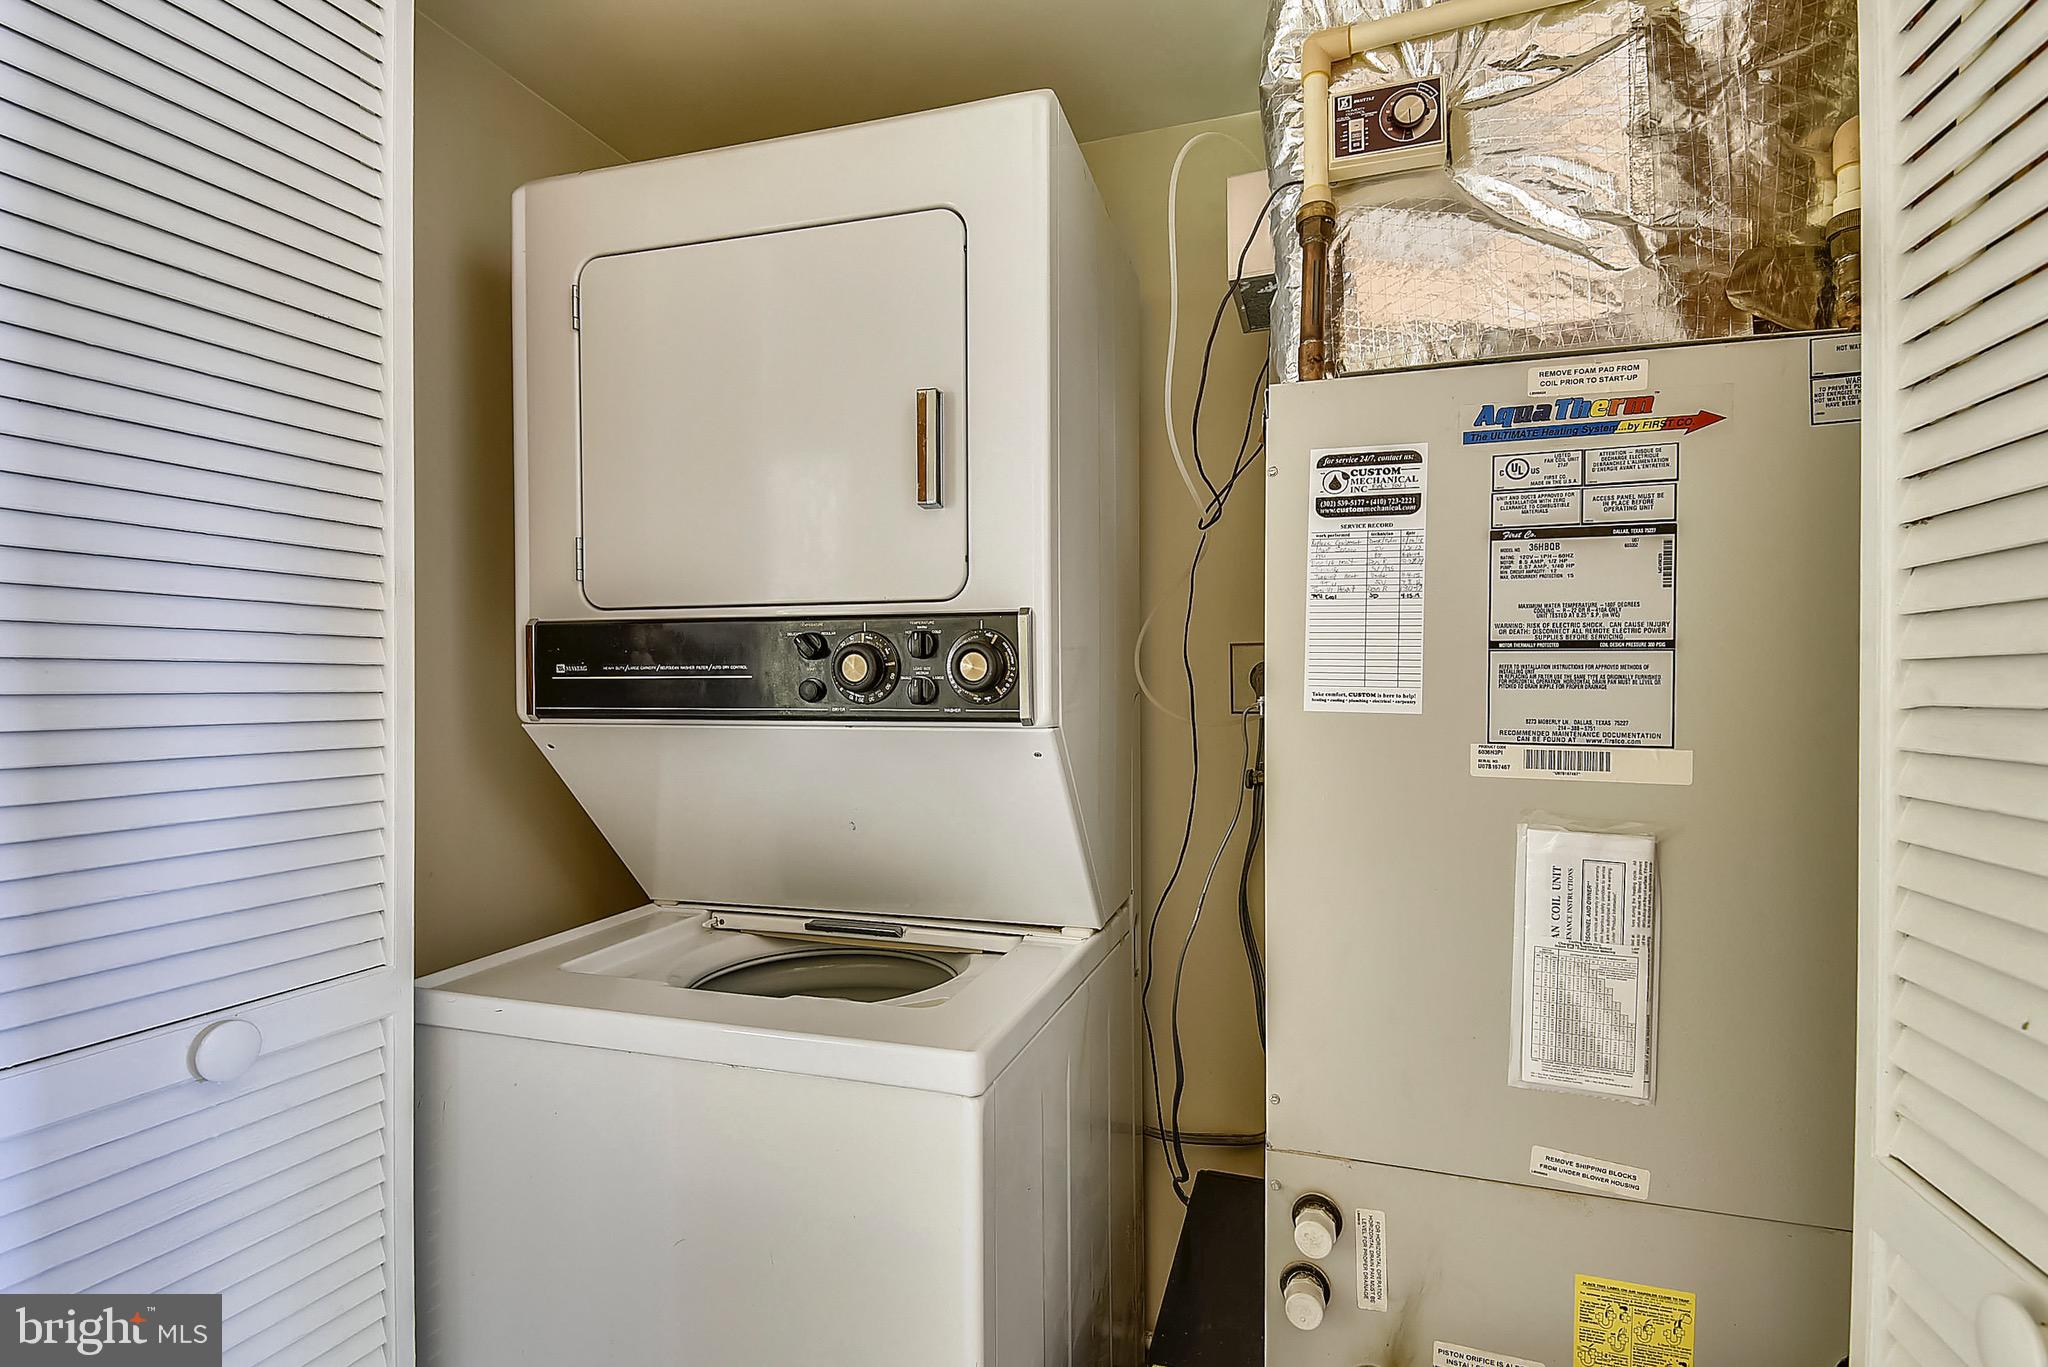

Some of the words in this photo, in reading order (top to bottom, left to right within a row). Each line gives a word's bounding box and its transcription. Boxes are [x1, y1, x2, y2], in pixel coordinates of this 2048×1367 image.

[1539, 368, 1572, 378] REMOVE
[1574, 366, 1596, 375] FOAM
[1599, 366, 1615, 374] PAD
[1617, 364, 1640, 372] FROM
[1540, 379, 1558, 387] COIL
[1599, 374, 1638, 383] START-UP
[1471, 433, 1488, 442] The
[1490, 430, 1538, 440] ULTIMATE
[1541, 427, 1578, 438] Heating
[1643, 418, 1672, 429] FIRST
[1676, 418, 1695, 427] CO.
[1322, 458, 1334, 466] for
[1350, 467, 1401, 477] CUSTOM
[1511, 463, 1524, 475] UL
[1530, 467, 1540, 475] US
[1350, 475, 1418, 485] MECHANICAL
[1350, 485, 1368, 493] INC
[1320, 505, 1416, 514] www.custommechanical.com
[1502, 530, 1522, 539] First
[1524, 530, 1536, 538] Co.
[1499, 729, 1550, 737] RECOMMENDED
[1552, 730, 1600, 738] MAINTENANCE
[1552, 865, 1562, 891] UNIT
[1552, 895, 1561, 921] COIL
[1545, 1155, 1573, 1167] REMOVE
[1575, 1162, 1607, 1174] SHIPPING
[1608, 1170, 1637, 1181] BLOCKS
[1539, 1163, 1558, 1172] FROM
[1559, 1168, 1581, 1178] UNDER
[1581, 1173, 1610, 1184] BLOWER
[1610, 1180, 1640, 1191] HOUSING
[1437, 1348, 1464, 1359] PISTON
[1466, 1355, 1495, 1366] ORIFICE
